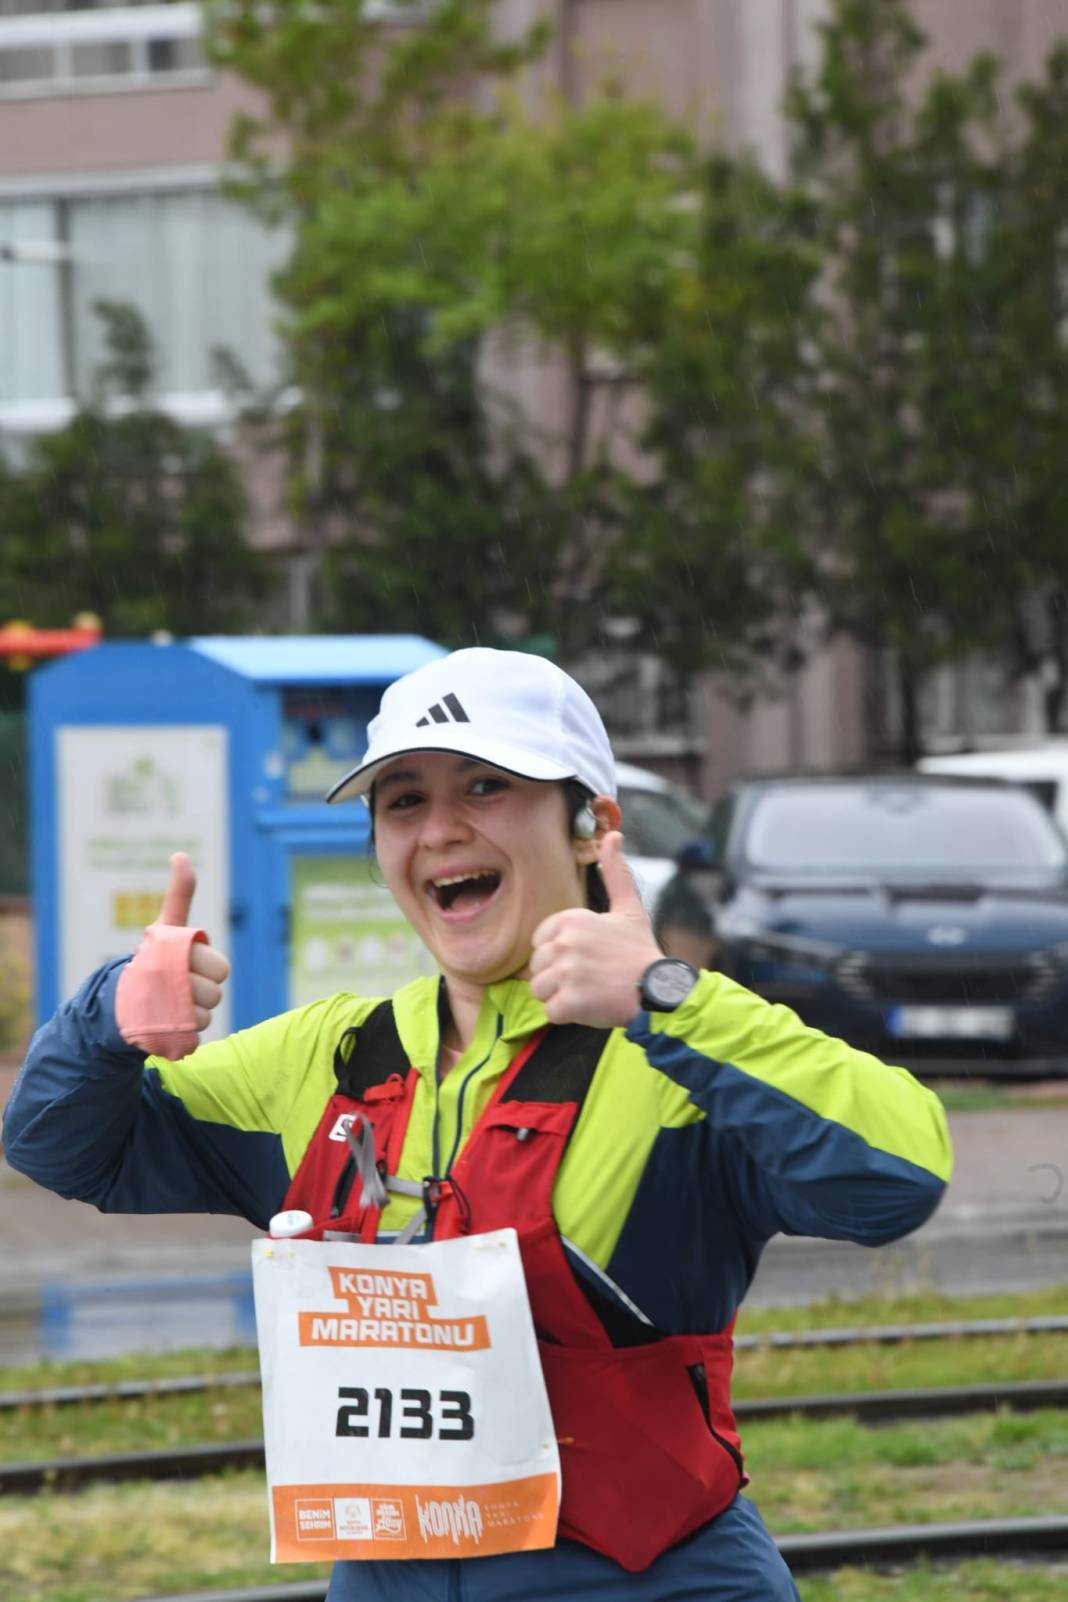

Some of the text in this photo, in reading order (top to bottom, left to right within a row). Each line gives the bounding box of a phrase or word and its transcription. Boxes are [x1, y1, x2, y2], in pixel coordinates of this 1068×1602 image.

[339, 1272, 428, 1299] KONYA
[357, 1296, 420, 1320] YARI
[311, 1318, 474, 1346] MARATONU
[336, 1387, 475, 1440] 2133
